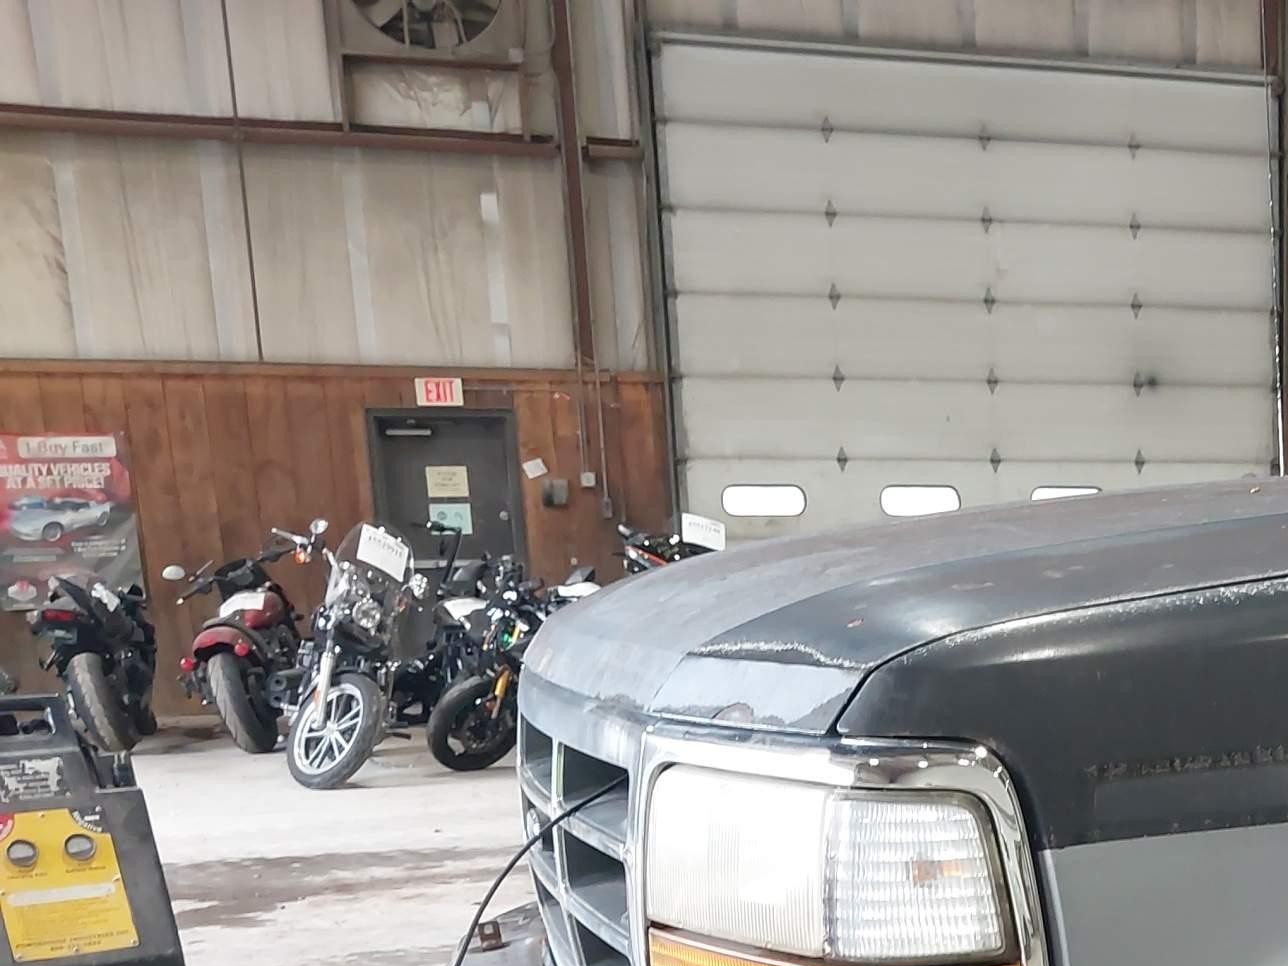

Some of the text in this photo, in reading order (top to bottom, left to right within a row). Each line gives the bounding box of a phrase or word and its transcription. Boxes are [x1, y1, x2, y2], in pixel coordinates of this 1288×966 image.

[423, 380, 455, 403] EXIT
[72, 440, 103, 454] Fast
[50, 462, 111, 476] VEHICLES
